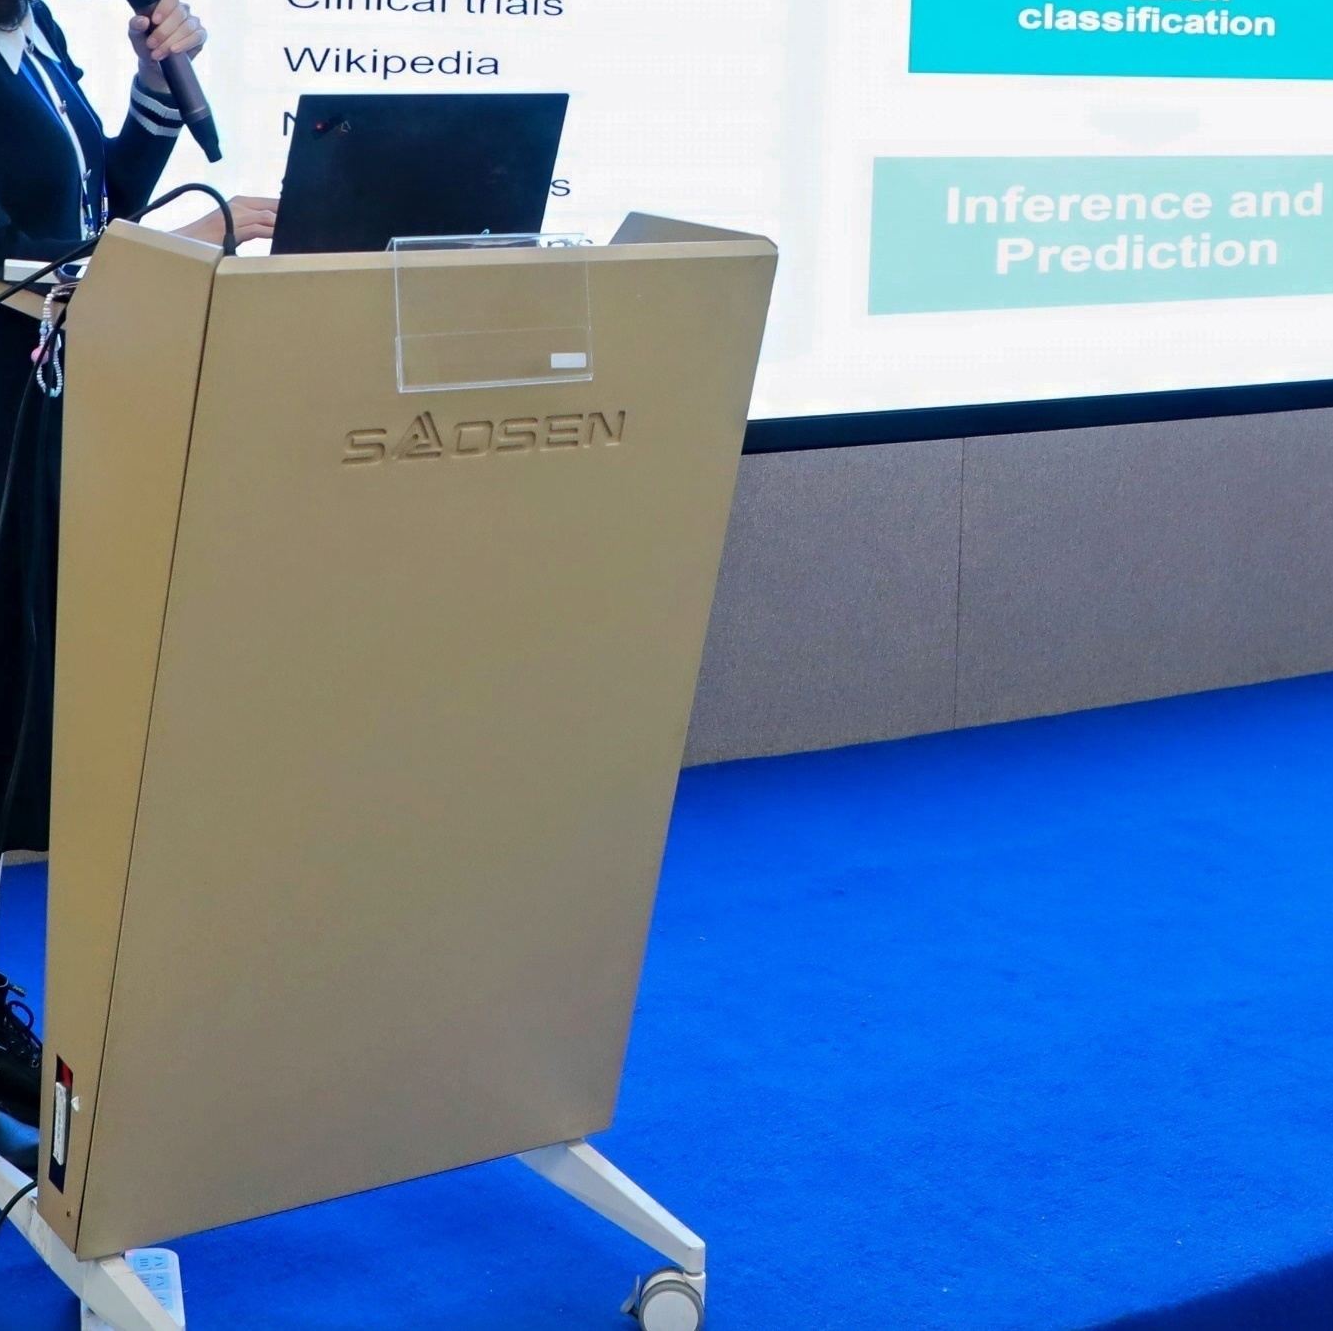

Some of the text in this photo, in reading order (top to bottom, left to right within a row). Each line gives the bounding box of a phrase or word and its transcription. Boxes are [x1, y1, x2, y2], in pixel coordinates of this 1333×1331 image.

[1018, 2, 1276, 37] classification
[283, 47, 499, 80] Wikipedia
[946, 181, 1324, 224] Inference and
[995, 232, 1278, 275] Prediction
